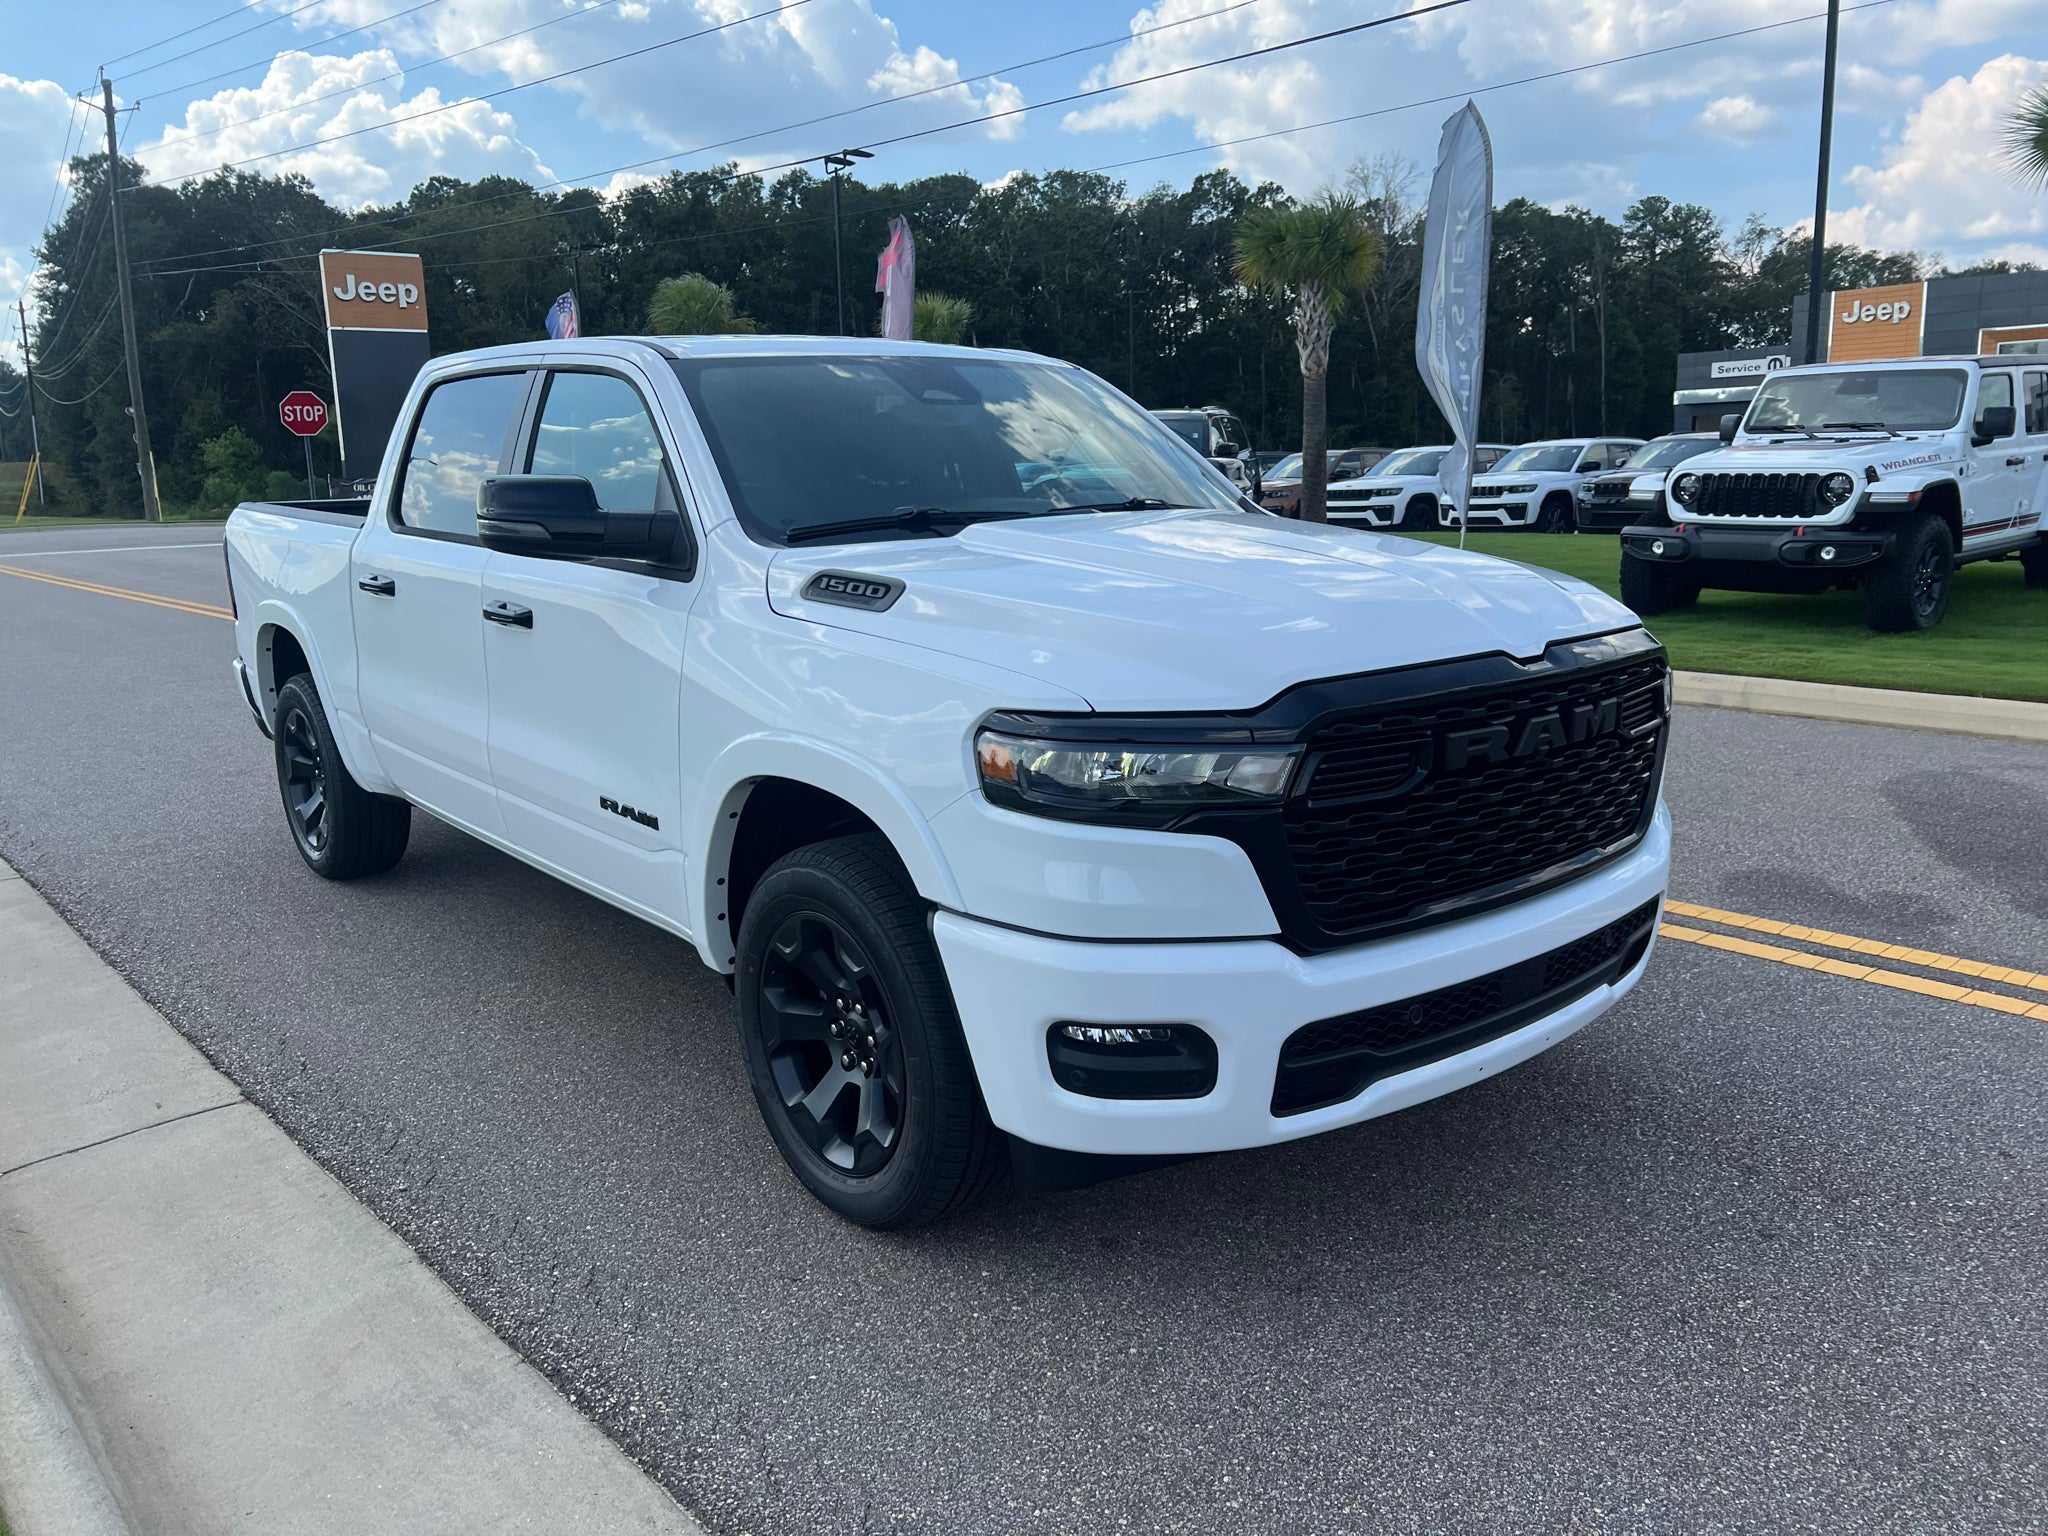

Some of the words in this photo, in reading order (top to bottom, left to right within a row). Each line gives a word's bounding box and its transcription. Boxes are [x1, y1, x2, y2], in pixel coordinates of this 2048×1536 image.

[333, 274, 419, 309] Jeep
[1842, 300, 1911, 324] Jeep
[1717, 364, 1761, 374] Service
[284, 405, 324, 422] STOP
[1881, 454, 1941, 470] WRANGLER
[353, 484, 367, 492] OIL
[819, 577, 886, 598] 1500
[1445, 697, 1618, 771] RAM
[600, 795, 660, 831] RAM
